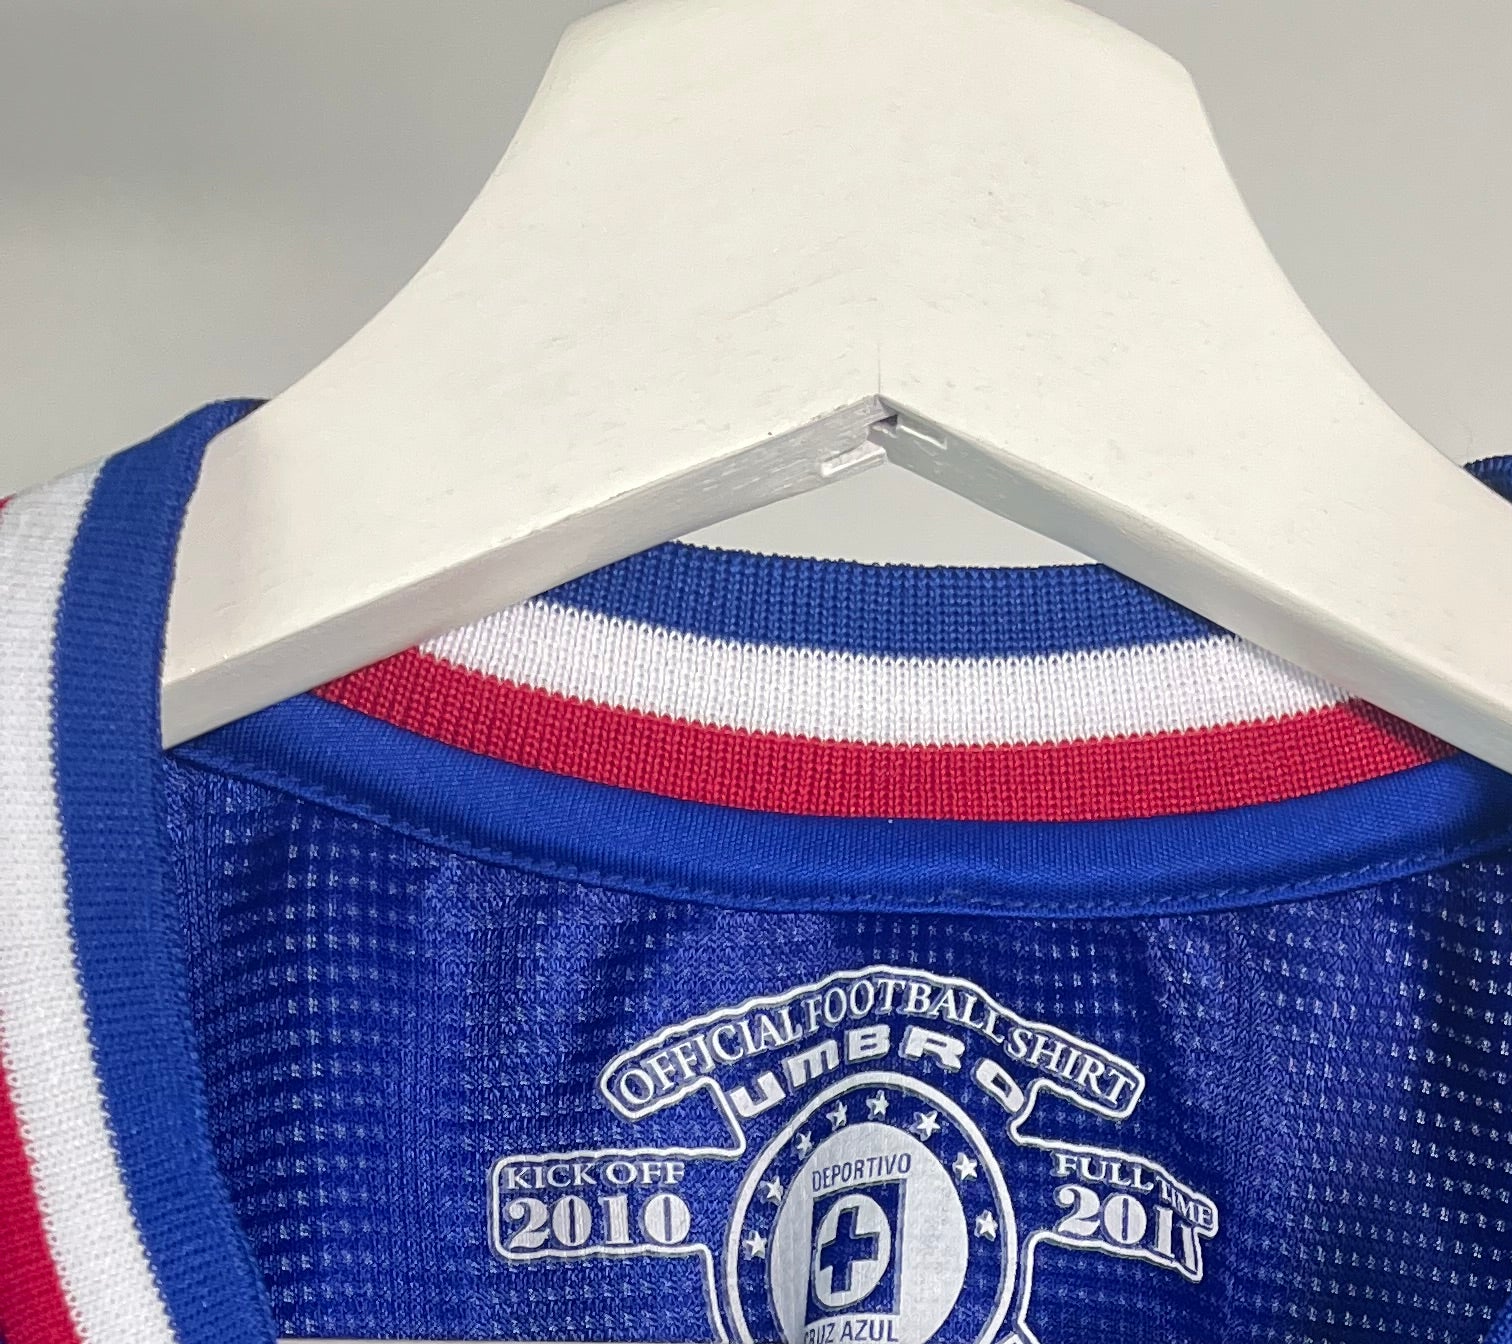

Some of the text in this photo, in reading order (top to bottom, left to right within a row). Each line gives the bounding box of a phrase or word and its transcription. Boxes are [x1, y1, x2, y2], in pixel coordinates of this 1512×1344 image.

[619, 978, 1137, 1107] OFFICIAL FOOTBALL SHIRT
[506, 1160, 685, 1190] KICK OFF
[811, 1152, 912, 1192] DEPORTIVO
[1053, 1152, 1214, 1227] FULL TIME
[508, 1192, 692, 1249] 2010
[1056, 1184, 1199, 1273] 2011
[840, 1319, 900, 1343] AZUL
